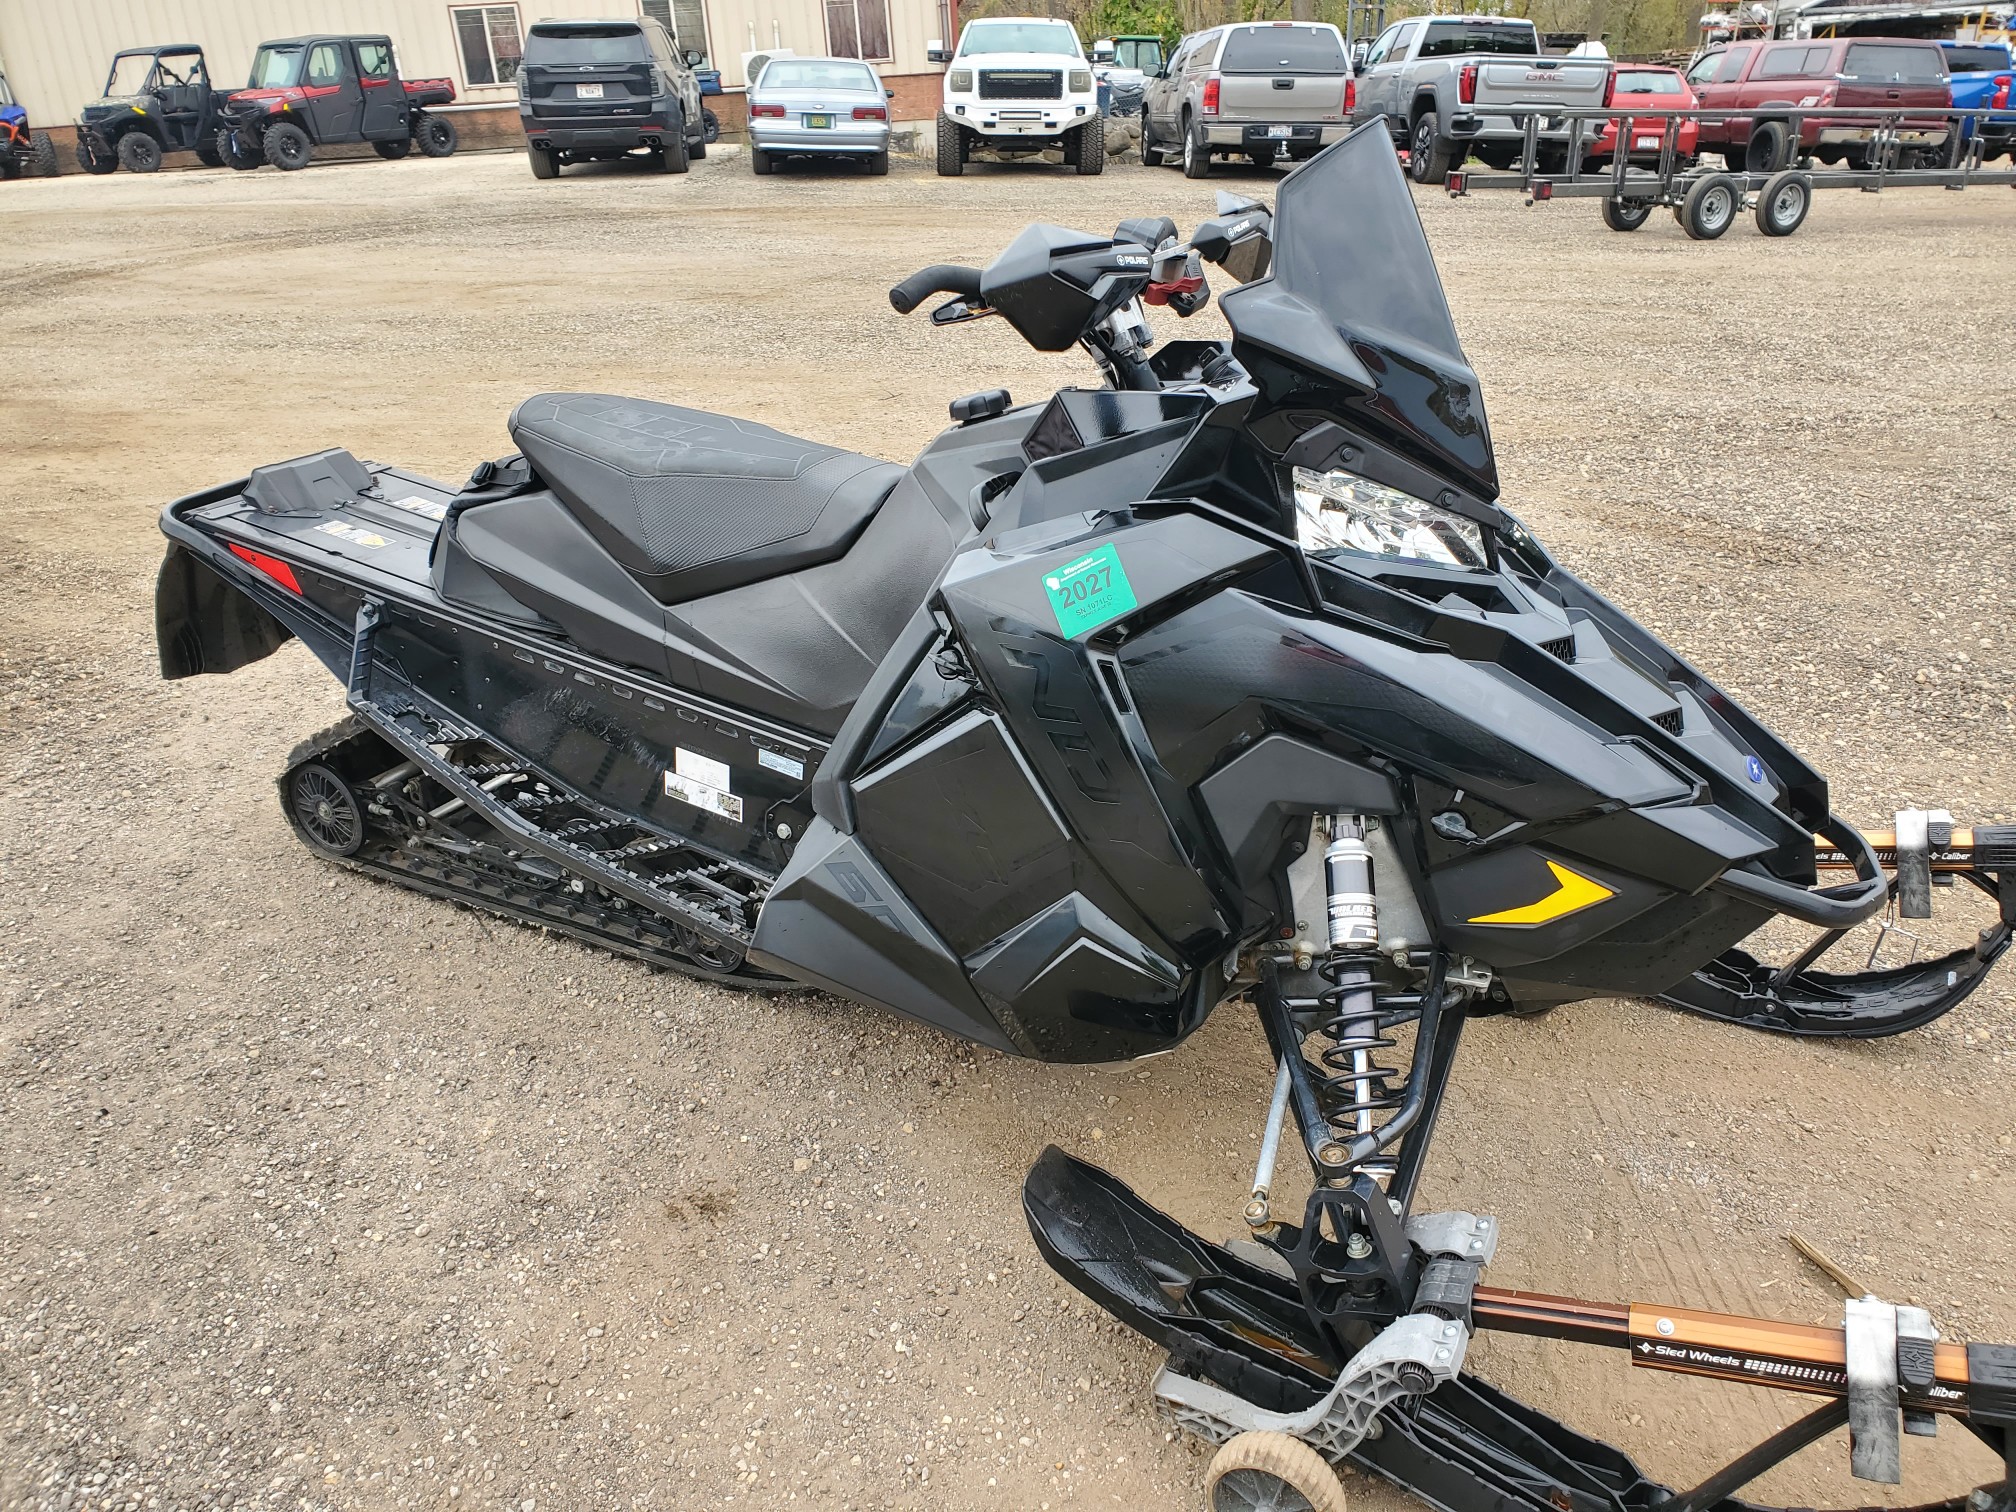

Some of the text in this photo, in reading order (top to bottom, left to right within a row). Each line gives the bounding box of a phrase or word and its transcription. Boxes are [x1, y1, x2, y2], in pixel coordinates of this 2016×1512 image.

[1525, 72, 1565, 81] GMC
[1233, 219, 1250, 233] POLARIS
[1125, 255, 1148, 265] POLARIS
[1063, 557, 1093, 575] Wisconsin
[1058, 565, 1111, 609] 2027
[1075, 607, 1087, 616] SN
[1941, 852, 1971, 861] Caliber
[1654, 1345, 1741, 1367] Sled Wheels
[1928, 1386, 1963, 1399] aliber
